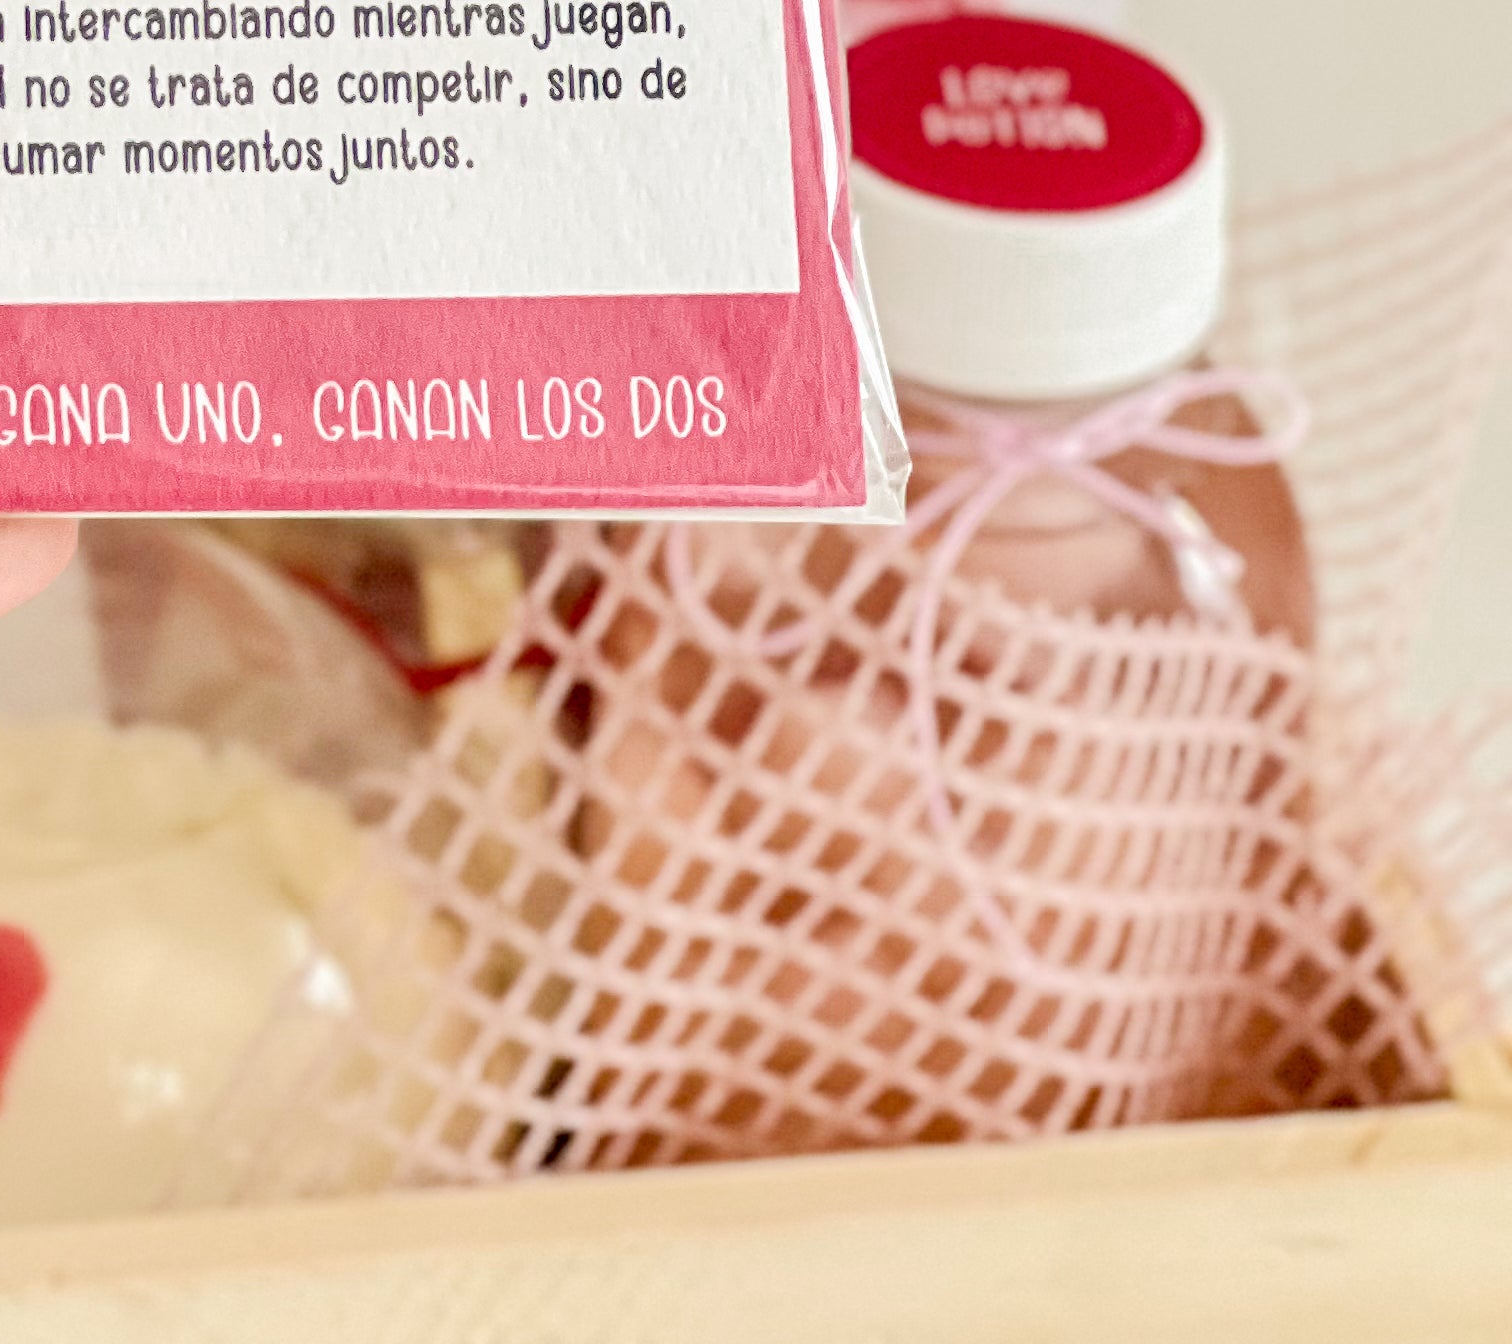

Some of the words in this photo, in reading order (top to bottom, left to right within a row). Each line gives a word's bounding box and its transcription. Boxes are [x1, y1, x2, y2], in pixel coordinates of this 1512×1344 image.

[533, 0, 686, 50] juegan,
[26, 75, 70, 108] no
[89, 74, 130, 108] se
[148, 64, 254, 108] trata
[273, 64, 319, 105] de
[338, 61, 528, 116] competir,
[548, 64, 622, 101] sino
[641, 58, 687, 100] de
[125, 129, 323, 174] momentos
[330, 128, 475, 185] juntos.
[312, 377, 492, 443] GANAN
[517, 376, 607, 442] LOS
[629, 374, 727, 440] DOS
